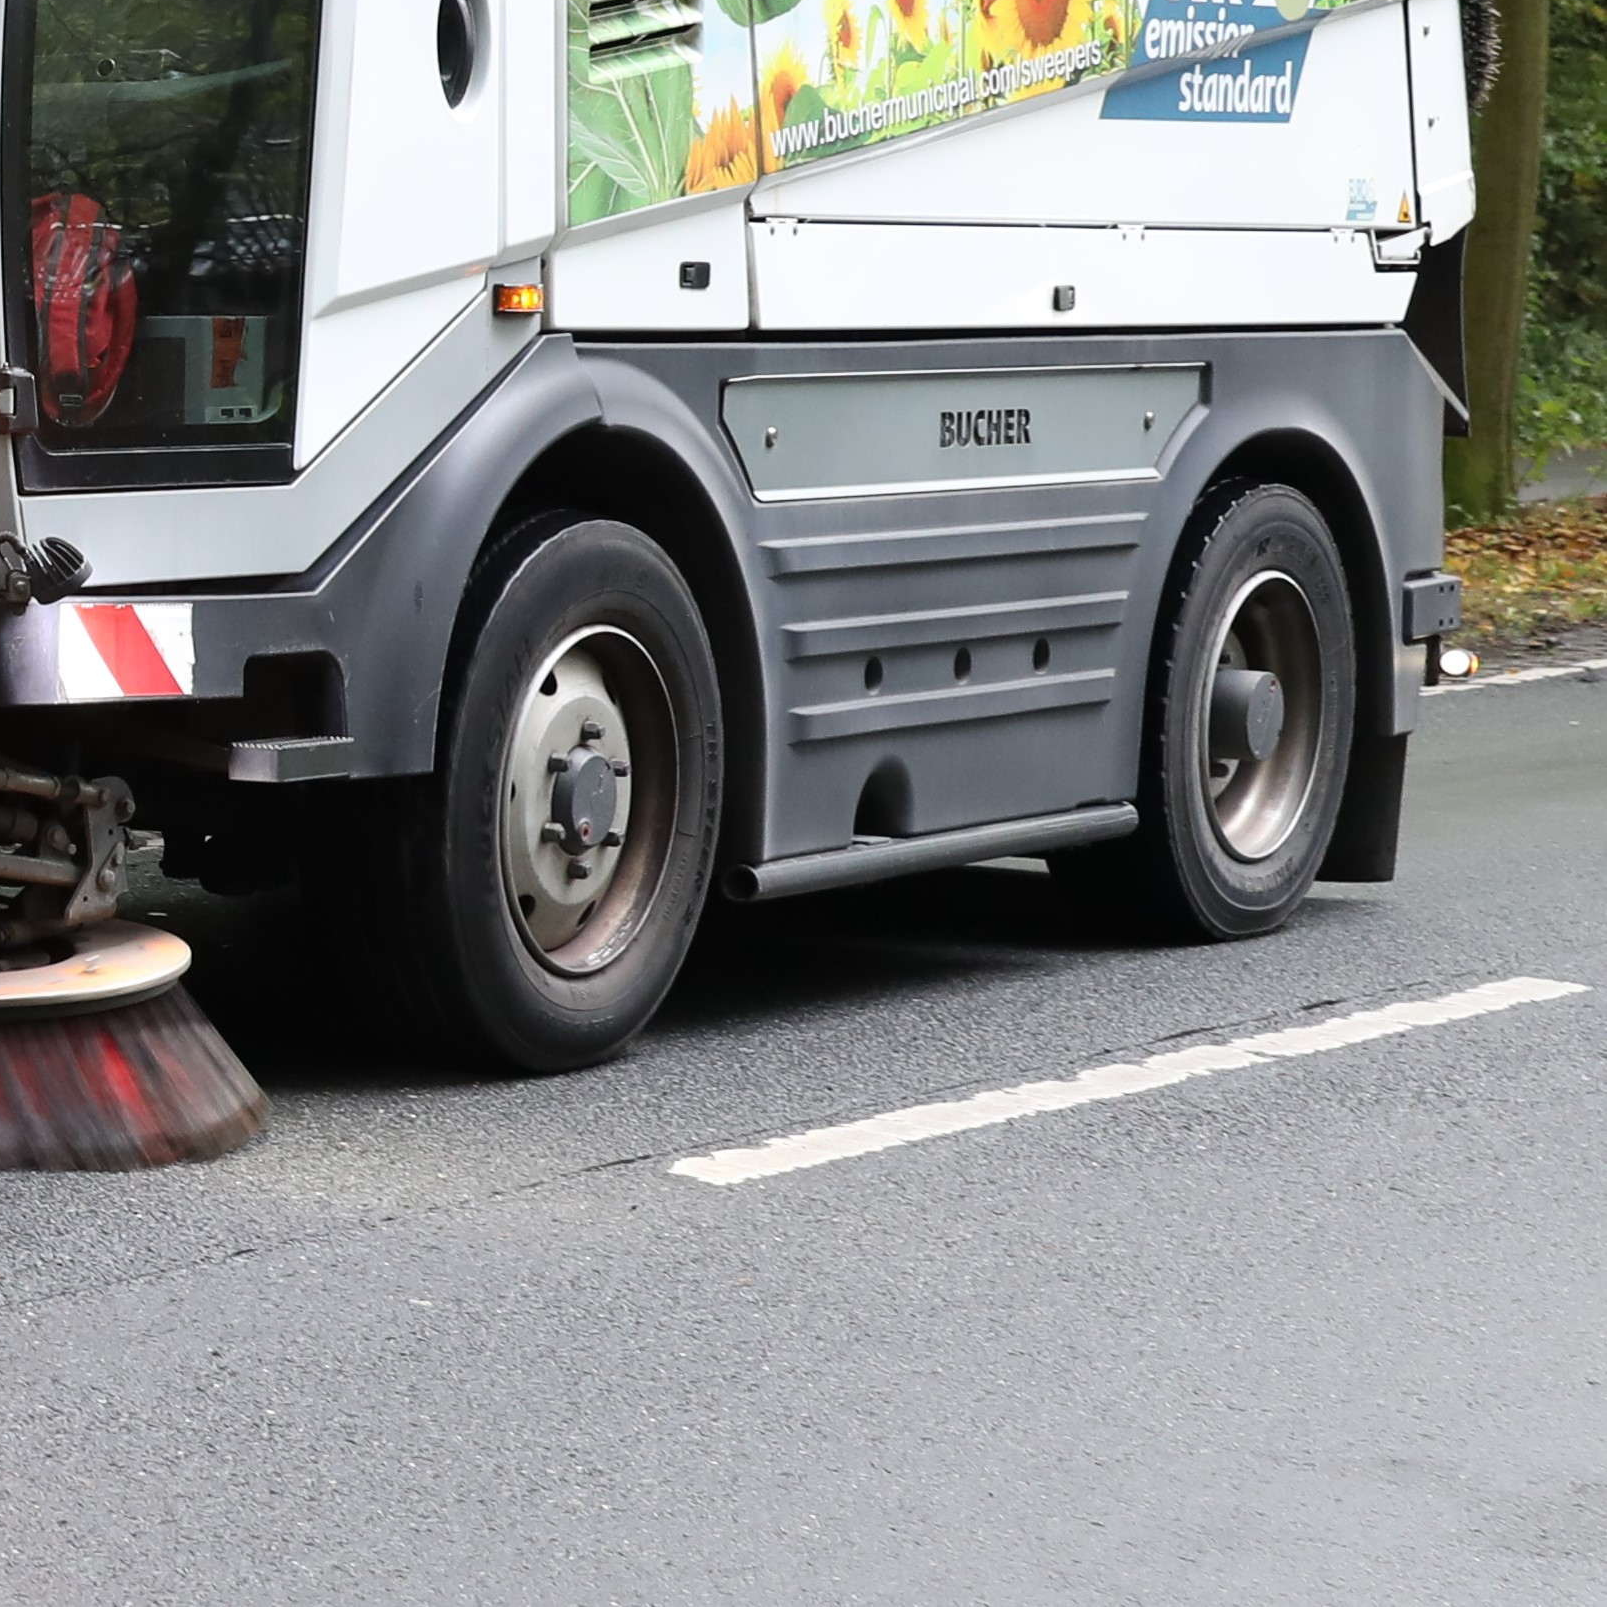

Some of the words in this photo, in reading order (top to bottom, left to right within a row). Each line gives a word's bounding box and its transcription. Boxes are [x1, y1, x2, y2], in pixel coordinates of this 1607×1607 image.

[770, 39, 1102, 157] www.buchermunicipal.com/sweepers
[1178, 59, 1293, 114] standard
[939, 408, 1031, 448] BUCHER
